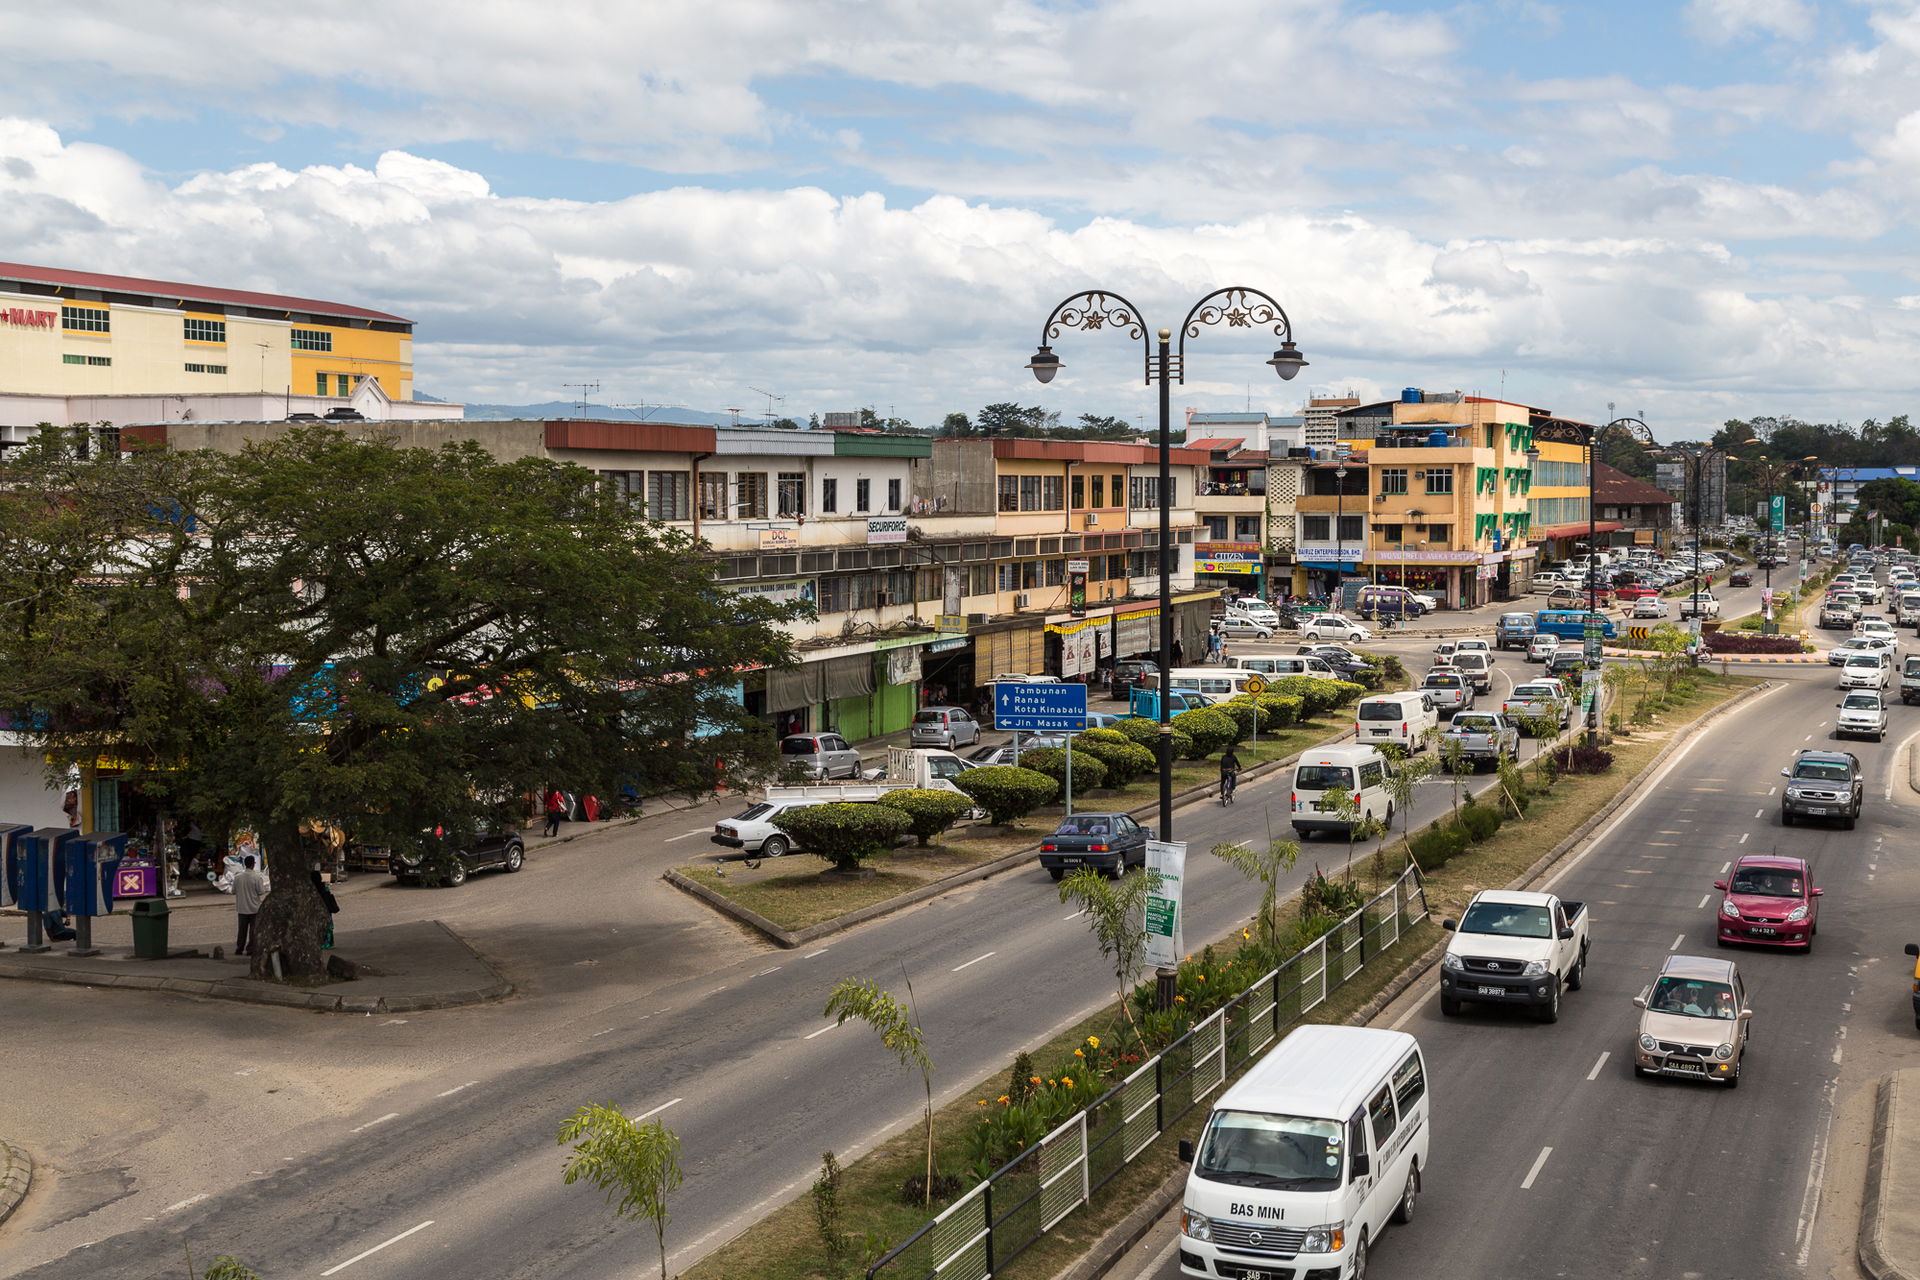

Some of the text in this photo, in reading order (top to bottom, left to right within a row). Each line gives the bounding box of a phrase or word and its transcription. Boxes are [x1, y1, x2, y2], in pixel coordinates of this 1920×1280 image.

[9, 307, 58, 329] MART
[868, 521, 907, 532] SECURIFORCE
[771, 530, 788, 540] DCL
[1214, 552, 1245, 560] CITIZEN
[1014, 686, 1067, 695] Tambunan
[1014, 696, 1046, 704] Ranau
[1014, 705, 1083, 714] Kota Kinabalu
[1037, 719, 1069, 727] Masak
[1722, 992, 1731, 1000] P
[1230, 1202, 1286, 1221] BAS MINI
[1246, 1270, 1261, 1280] SAB
